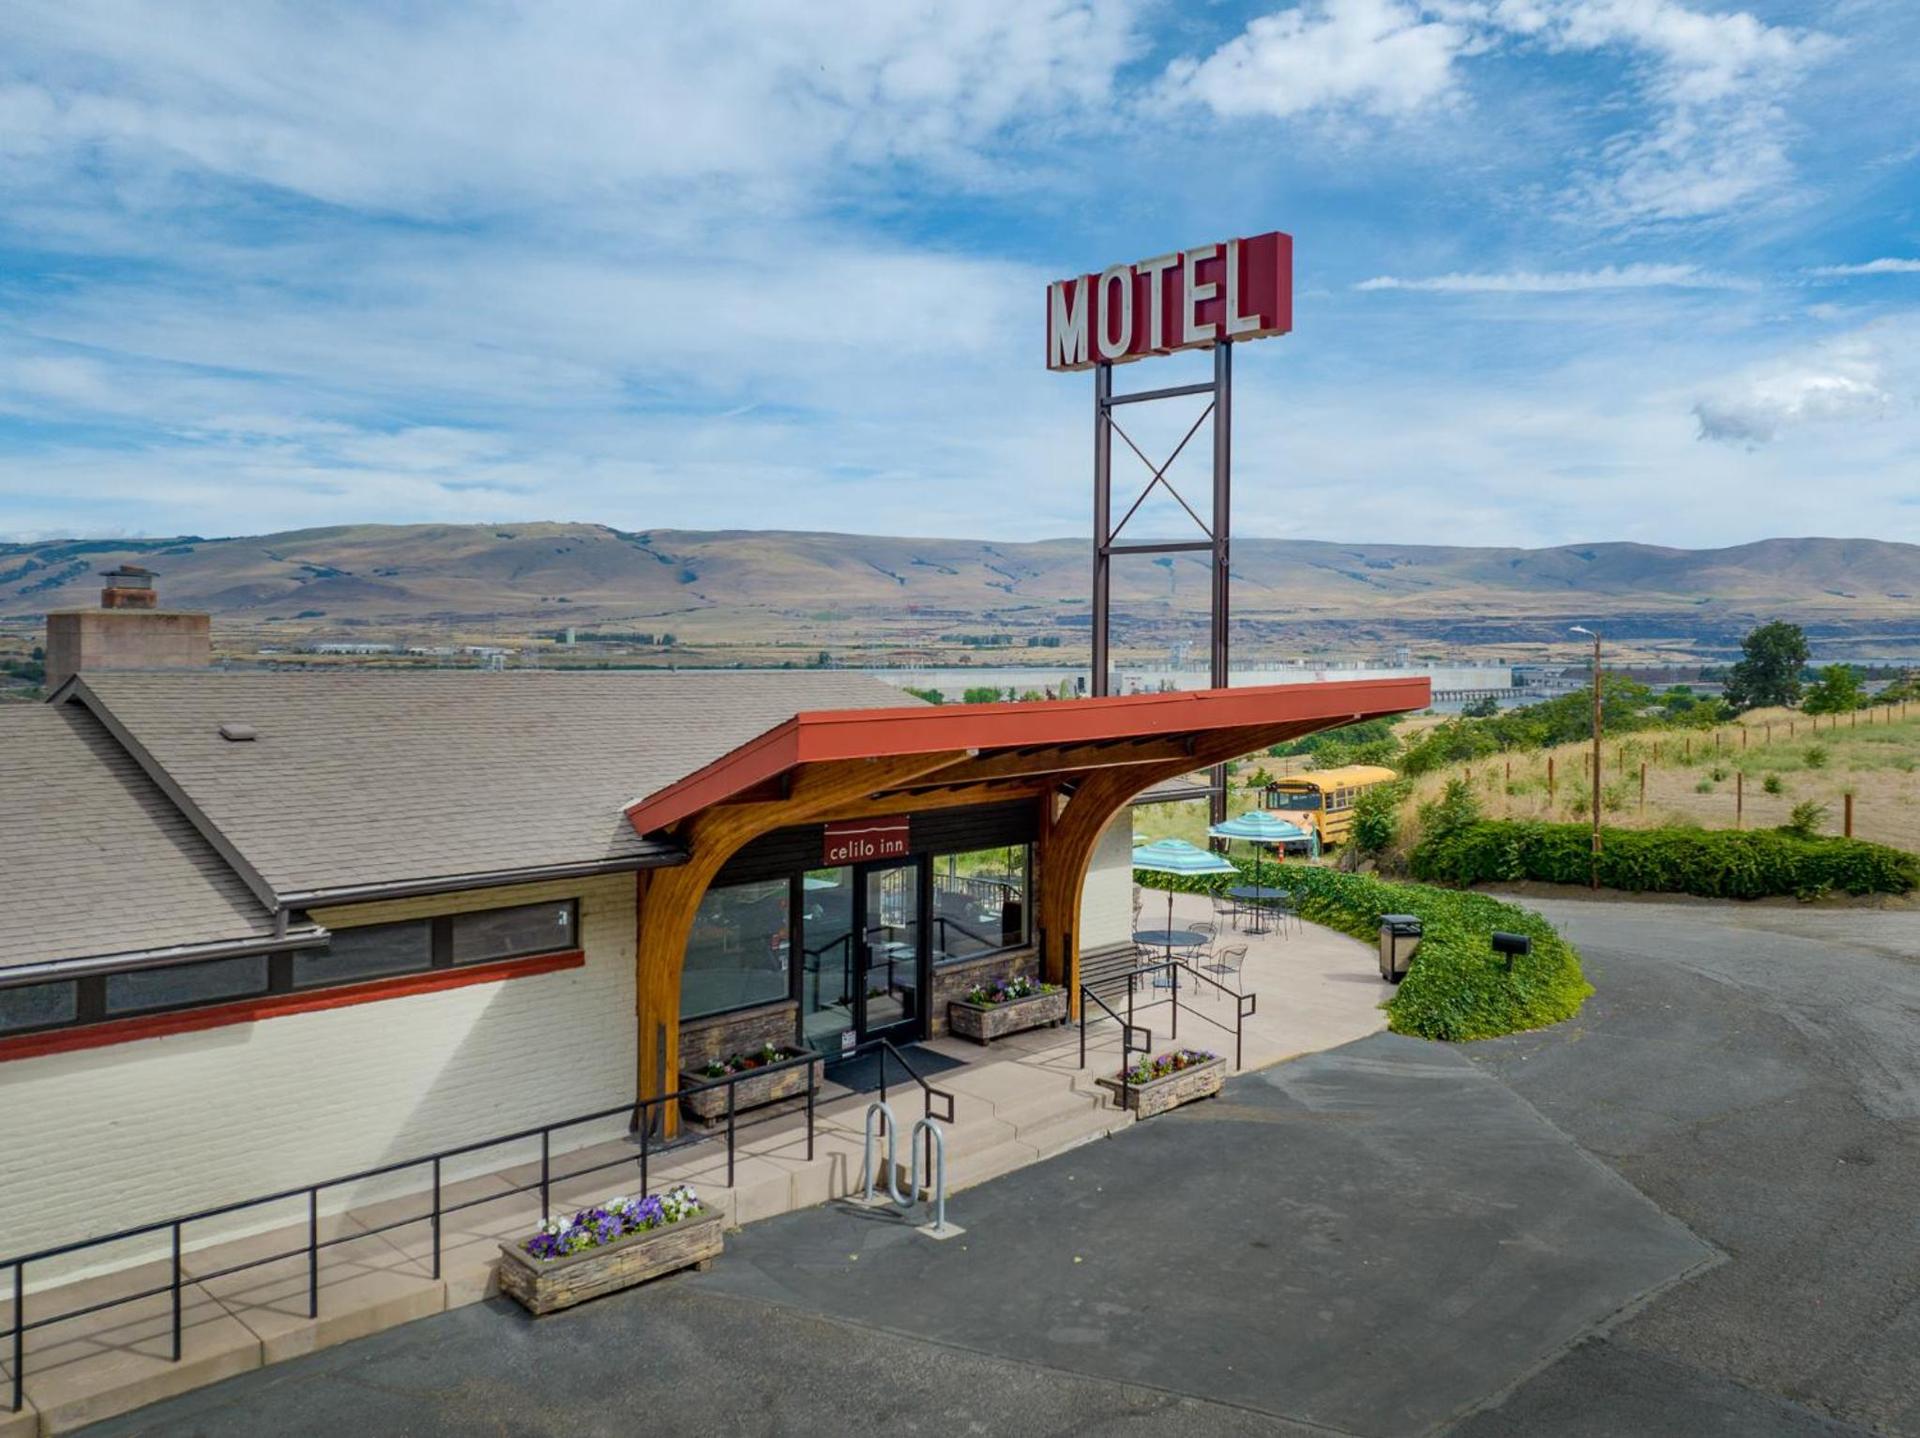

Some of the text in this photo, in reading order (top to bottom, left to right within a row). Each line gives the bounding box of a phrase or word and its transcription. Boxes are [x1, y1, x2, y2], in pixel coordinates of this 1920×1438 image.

[1050, 238, 1261, 368] MOTEL
[830, 838, 903, 860] celilo inn
